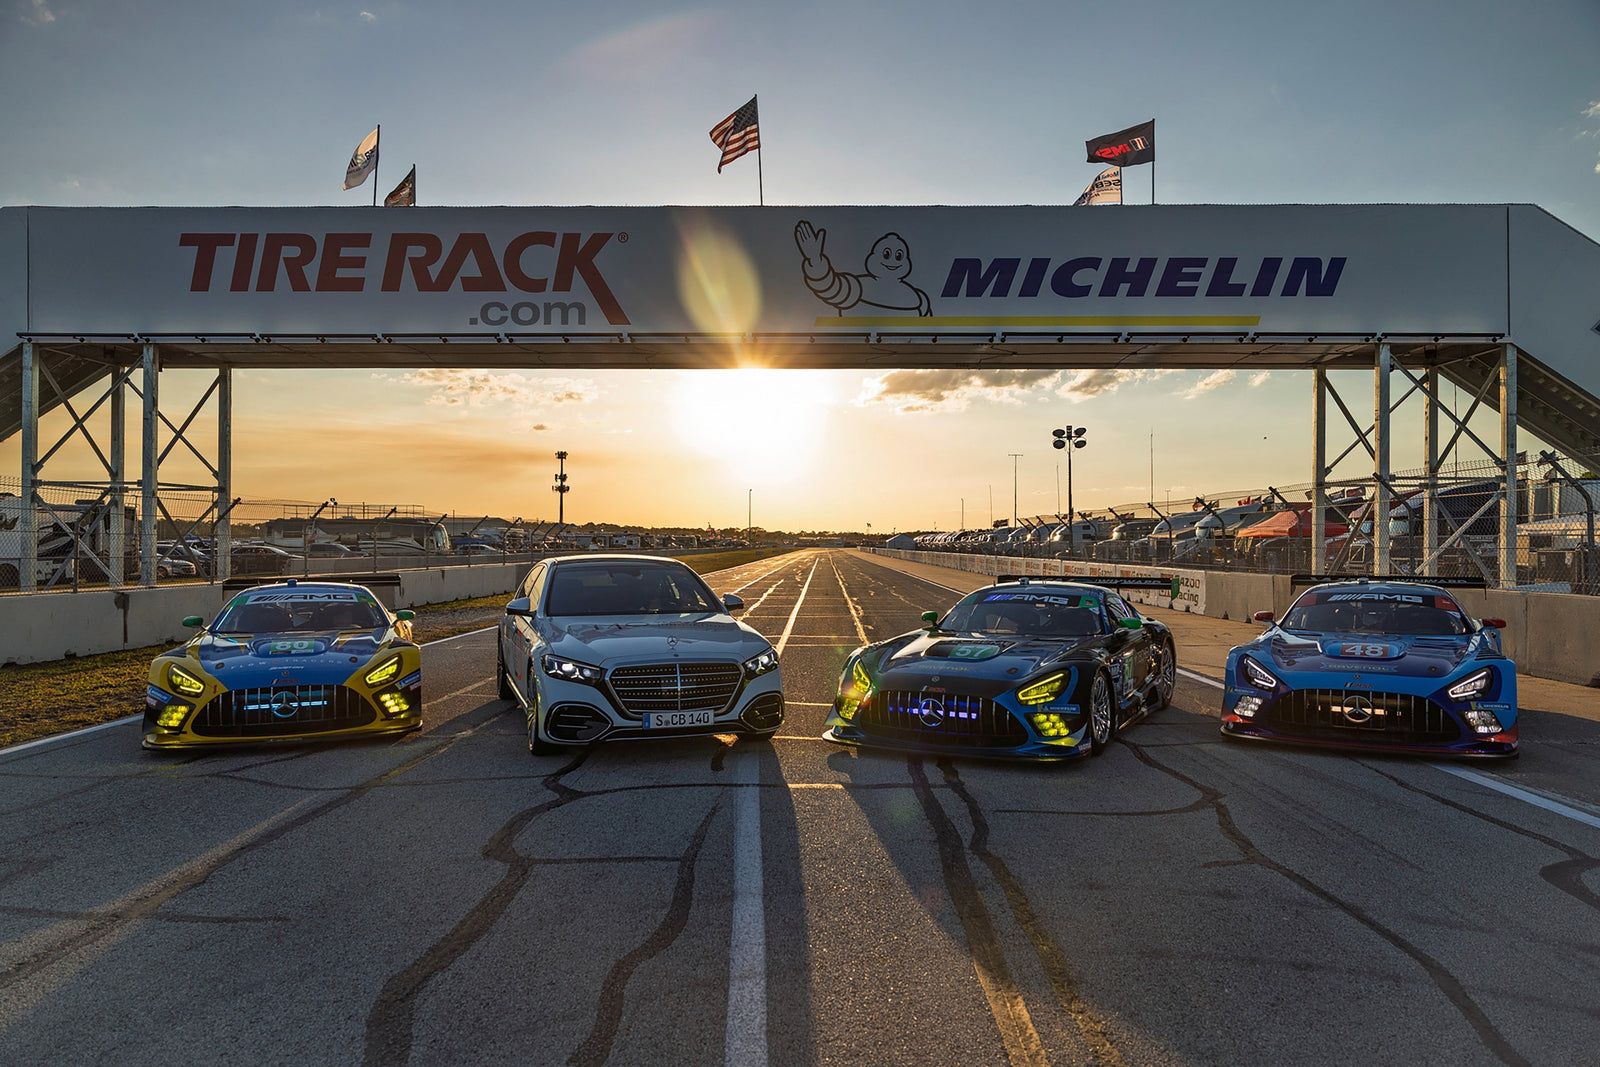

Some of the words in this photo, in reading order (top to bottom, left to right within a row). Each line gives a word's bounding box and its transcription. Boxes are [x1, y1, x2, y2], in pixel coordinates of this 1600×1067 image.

[178, 232, 373, 293] TIRE
[380, 230, 632, 326] RACK
[939, 256, 1348, 298] MICHELIN
[468, 301, 587, 326] .com
[1175, 575, 1200, 589] AZOO
[1009, 594, 1069, 605] AMG
[1177, 590, 1200, 606] acing
[1355, 593, 1423, 603] AMG
[275, 640, 309, 651] 80
[955, 645, 992, 657] 57
[1345, 645, 1384, 657] 48
[656, 715, 663, 726] S
[671, 714, 686, 725] CB
[689, 713, 709, 724] 140
